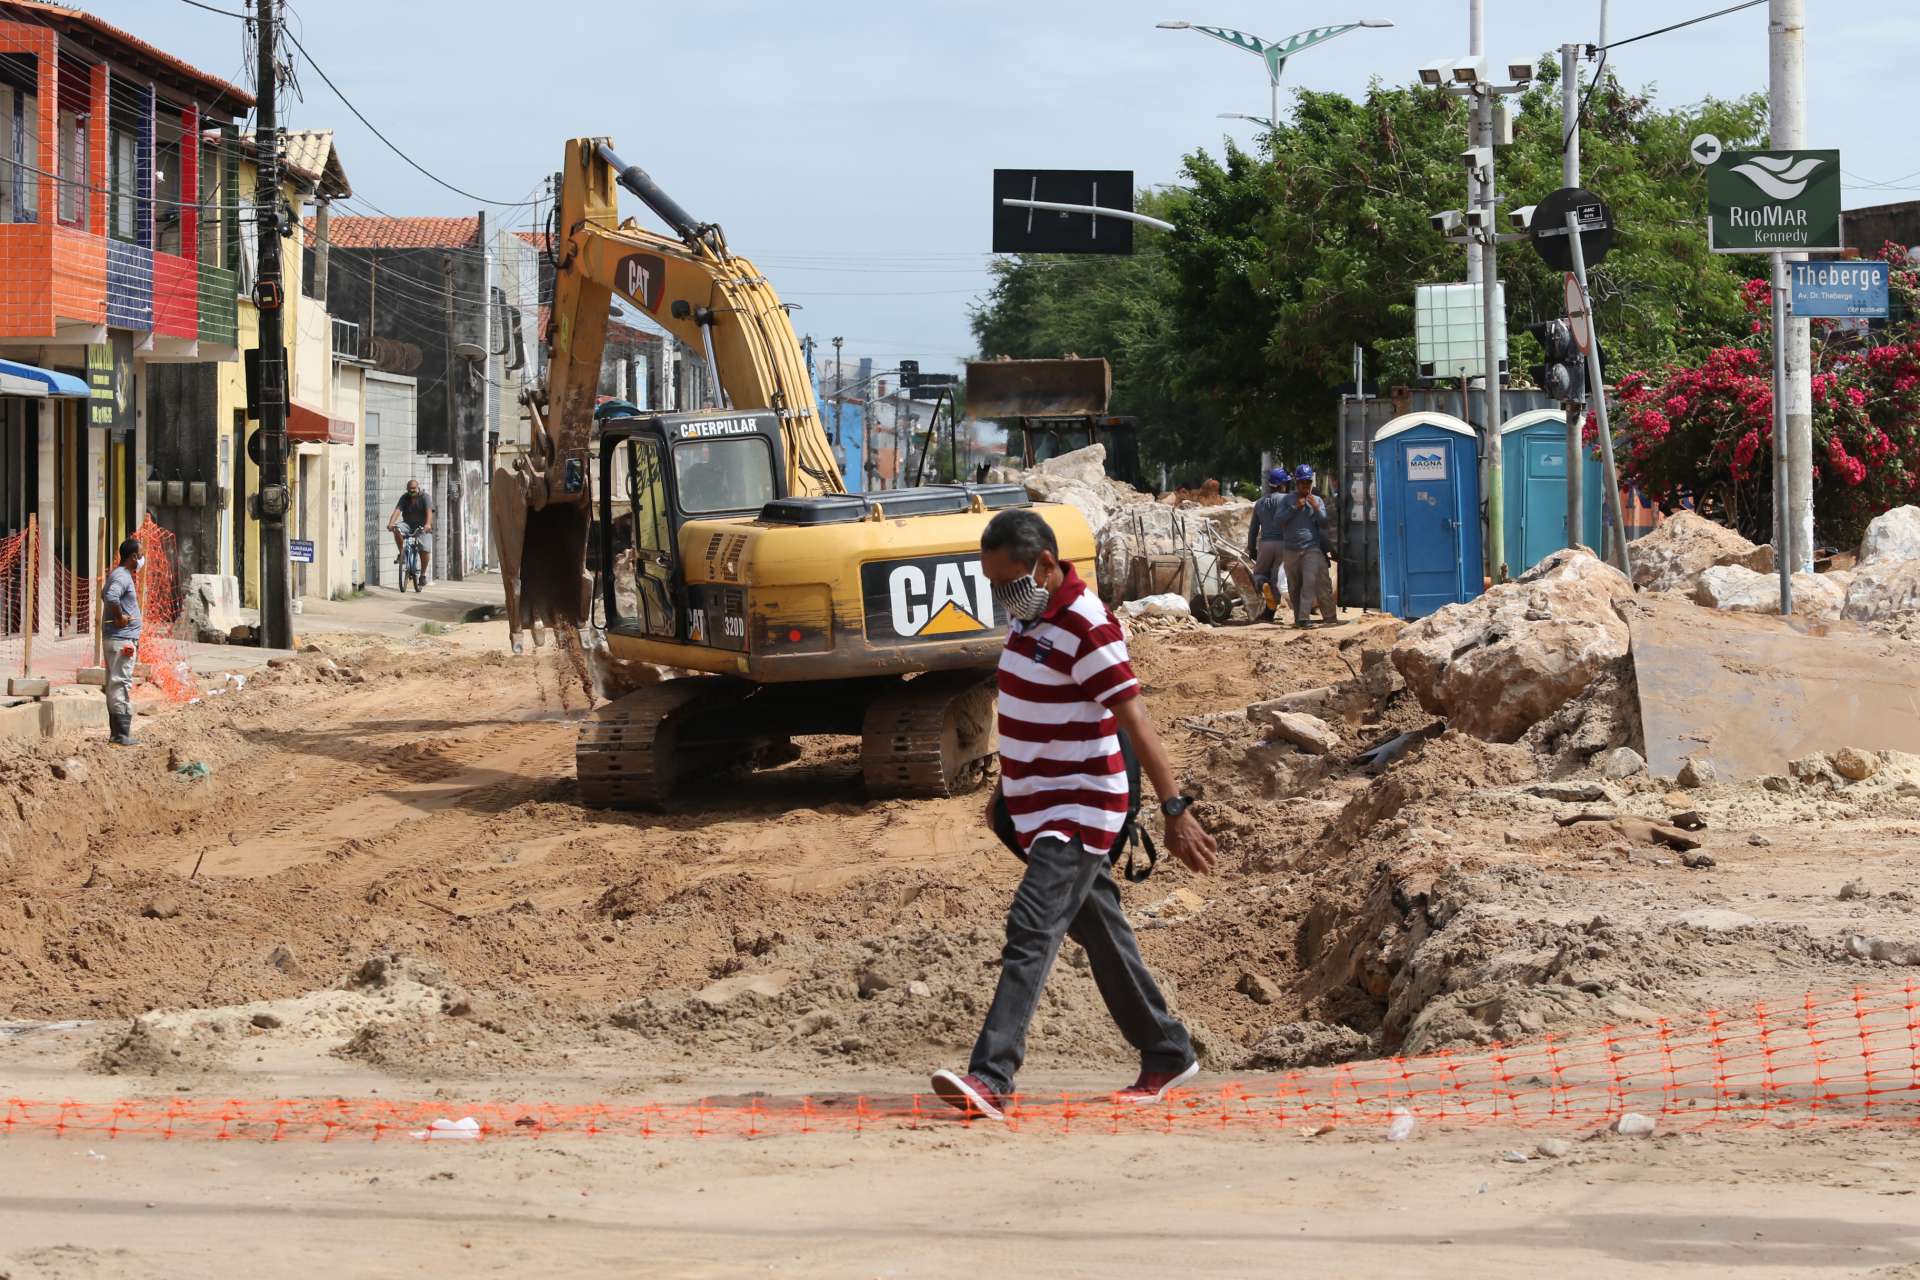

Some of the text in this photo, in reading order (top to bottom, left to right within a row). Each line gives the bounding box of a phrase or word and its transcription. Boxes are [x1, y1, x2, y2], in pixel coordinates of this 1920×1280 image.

[1754, 229, 1808, 245] Kennedy
[629, 260, 650, 307] CAT
[1797, 265, 1881, 291] Theberge
[1798, 292, 1808, 300] Av.
[1822, 292, 1853, 300] Theberge
[680, 418, 758, 438] CATERPILLAR
[889, 560, 995, 637] CAT
[687, 608, 704, 640] CAT
